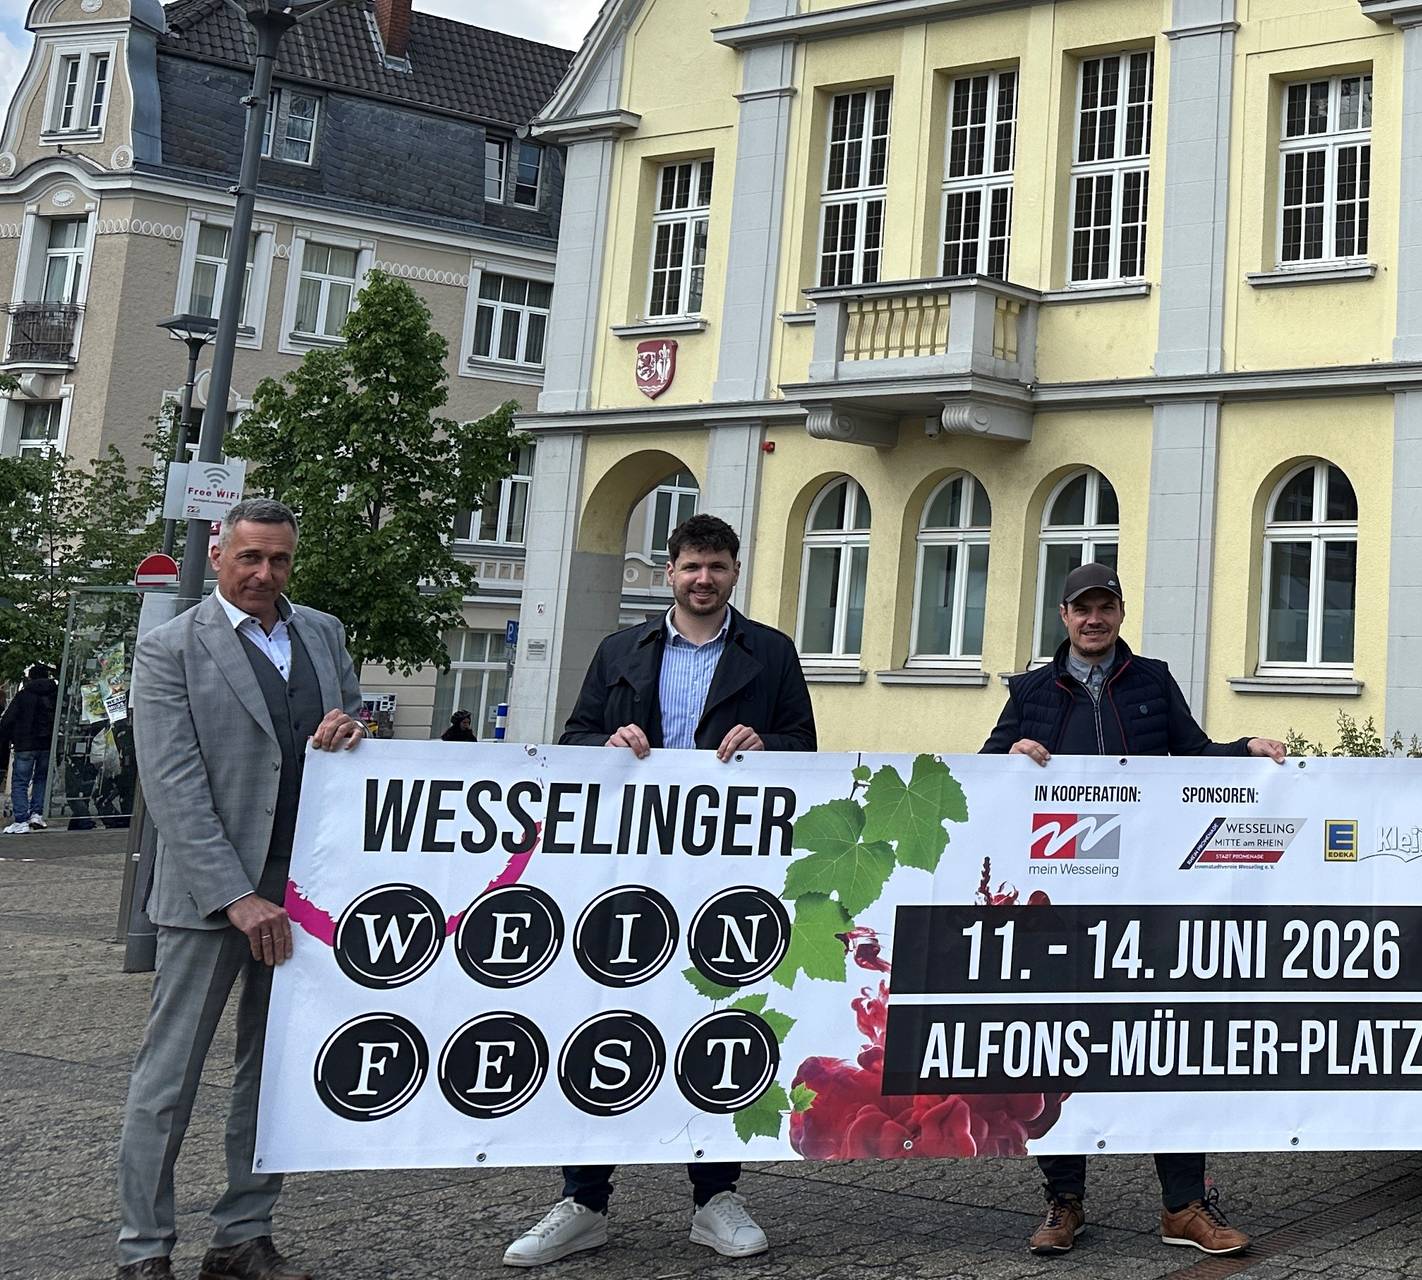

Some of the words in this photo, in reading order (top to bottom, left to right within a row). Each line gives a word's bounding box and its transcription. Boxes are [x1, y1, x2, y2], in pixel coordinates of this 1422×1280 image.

[187, 487, 212, 497] Free
[216, 489, 240, 500] WiFi
[1034, 785, 1048, 801] IN
[1050, 785, 1142, 802] KOOPERATION:
[1182, 787, 1259, 803] SPONSOREN:
[362, 779, 798, 857] WESSELINGER
[1226, 823, 1295, 834] WESSELING
[1214, 839, 1241, 847] MITTE
[1257, 839, 1284, 847] RHEIN
[1028, 864, 1058, 875] mein
[1060, 863, 1119, 878] Wesseling
[355, 911, 768, 965] WEIN
[961, 920, 1031, 980] 11.
[1048, 944, 1068, 955] -
[1087, 920, 1154, 980] 14.
[1169, 919, 1267, 980] JUNI
[1282, 919, 1400, 980] 2026
[347, 1036, 752, 1096] FEST
